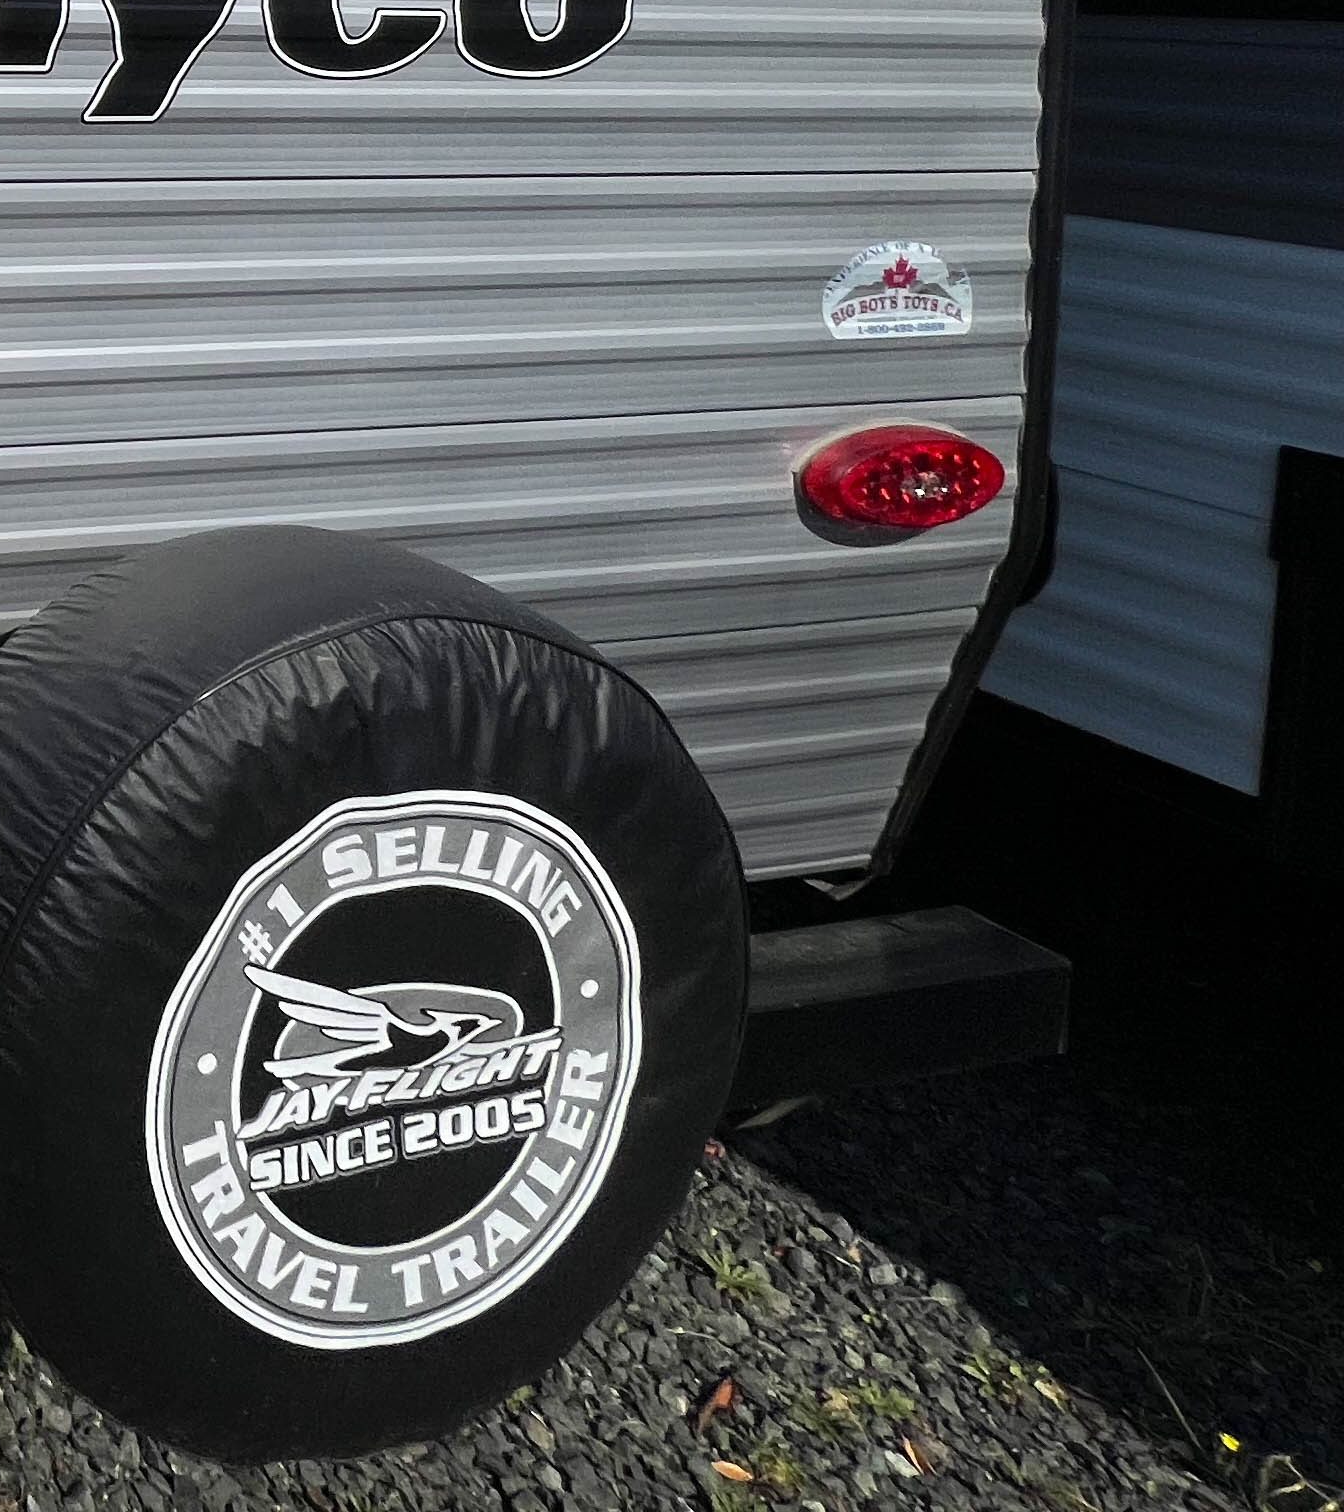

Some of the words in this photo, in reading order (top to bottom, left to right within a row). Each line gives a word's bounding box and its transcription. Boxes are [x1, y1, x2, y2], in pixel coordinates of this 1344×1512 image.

[831, 303, 856, 326] BIG
[239, 884, 305, 965] #1
[321, 825, 582, 938] SELLING
[182, 1120, 368, 1313] TRAVEL
[392, 1048, 609, 1307] TRAILER
[250, 1119, 394, 1190] SINCE
[404, 1093, 546, 1152] 2005
